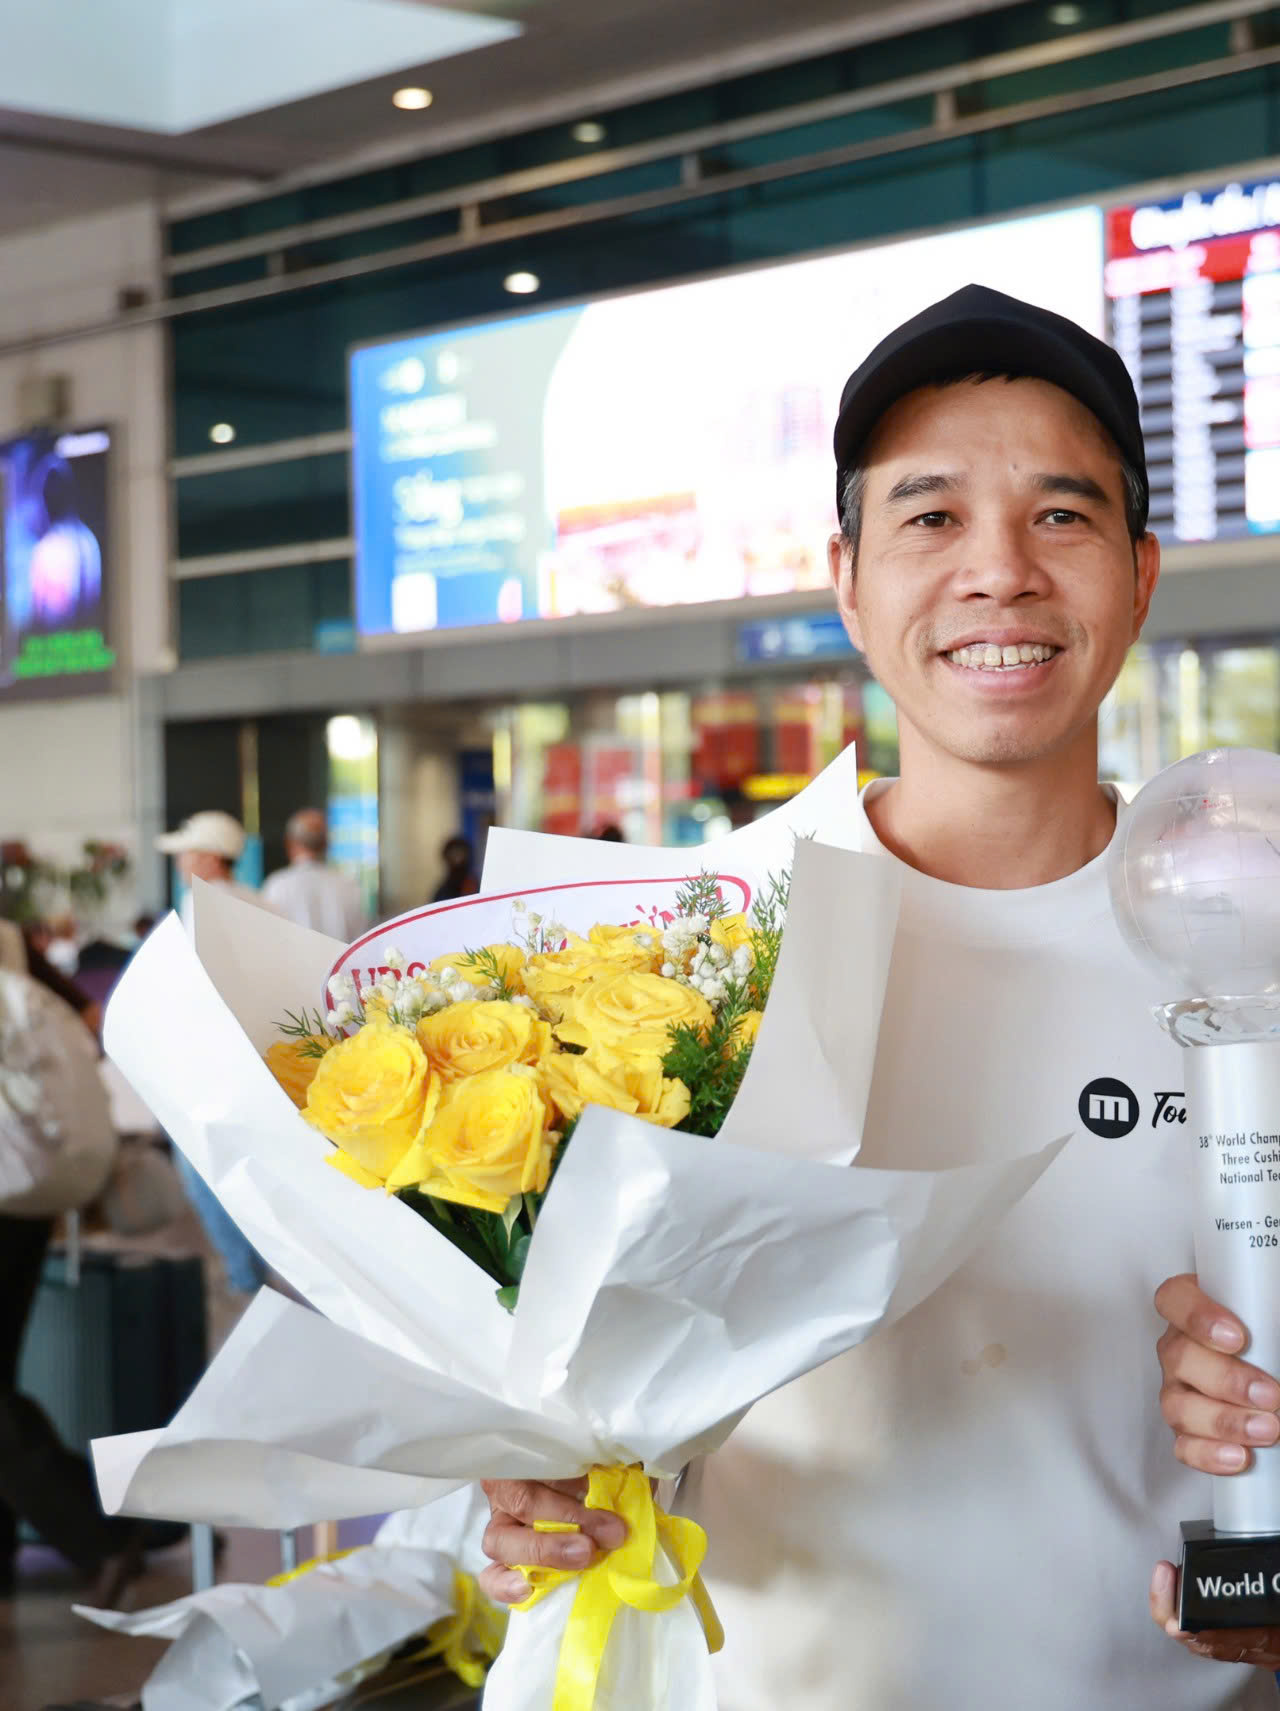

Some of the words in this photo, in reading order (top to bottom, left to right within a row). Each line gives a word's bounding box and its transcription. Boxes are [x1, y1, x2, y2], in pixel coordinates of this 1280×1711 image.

[1216, 1133, 1246, 1147] World
[1222, 1153, 1250, 1165] Three
[1220, 1169, 1263, 1184] National
[1215, 1218, 1252, 1231] Viersen
[1249, 1234, 1278, 1248] 2026
[1197, 1572, 1264, 1598] World
